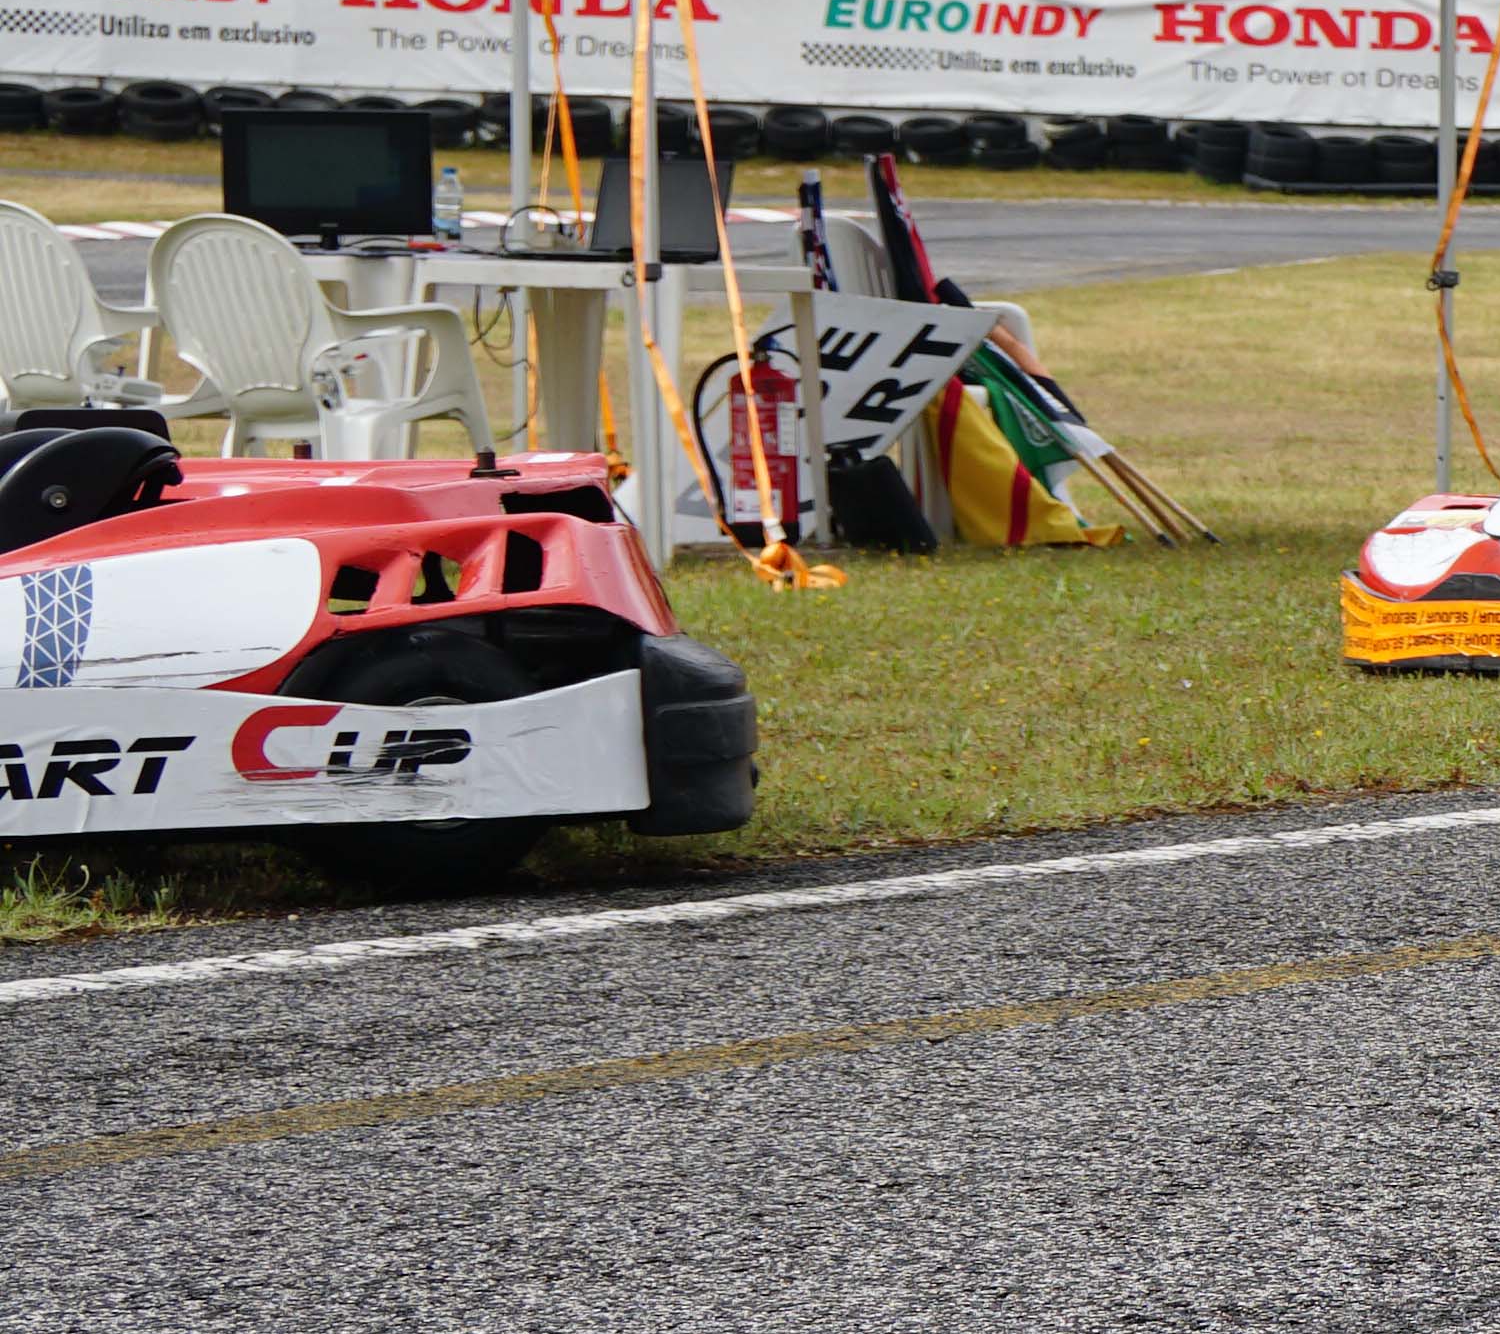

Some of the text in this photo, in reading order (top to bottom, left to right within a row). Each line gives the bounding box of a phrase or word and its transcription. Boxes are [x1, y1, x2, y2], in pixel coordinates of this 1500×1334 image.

[100, 15, 316, 46] Utiliza em exclusivo
[371, 27, 427, 51] The
[436, 28, 526, 53] Powe
[576, 34, 689, 60] Drems
[1153, 3, 1498, 54] HONDA
[1187, 61, 1238, 83] The
[1248, 63, 1330, 86] Power
[1341, 66, 1367, 88] of
